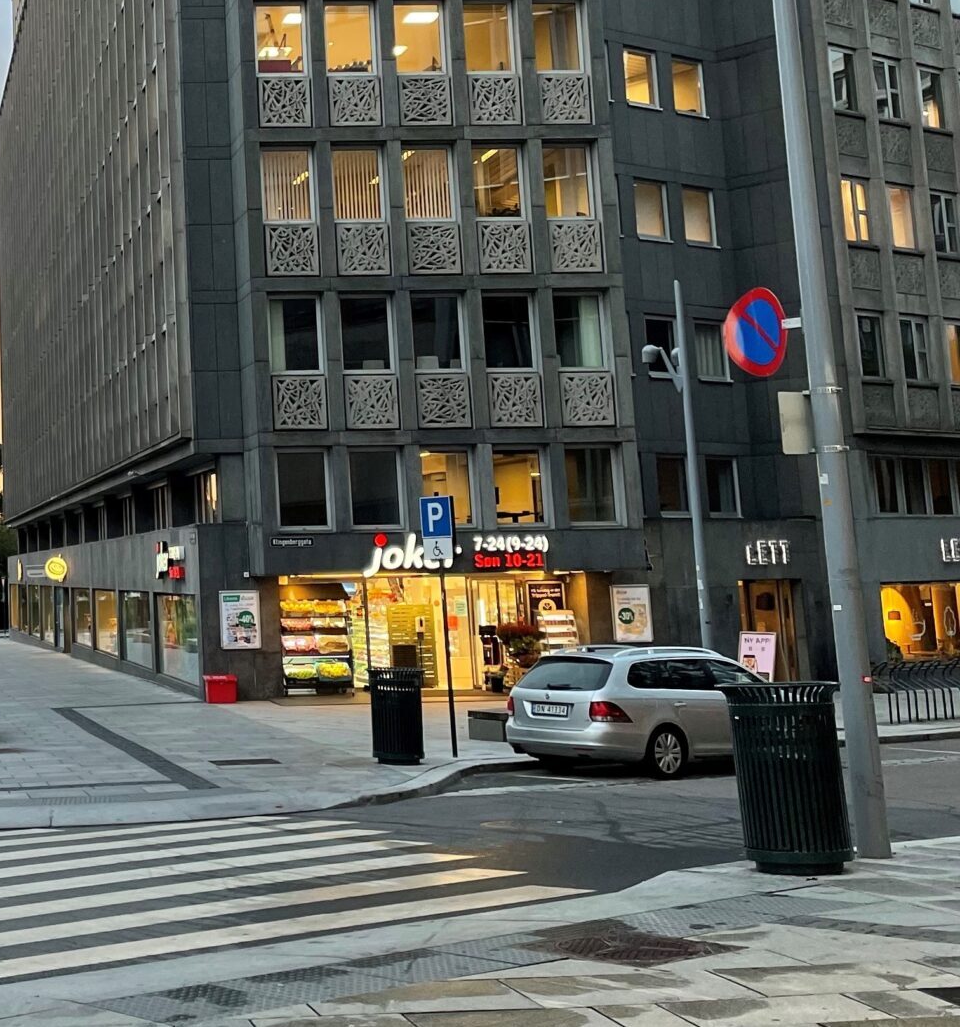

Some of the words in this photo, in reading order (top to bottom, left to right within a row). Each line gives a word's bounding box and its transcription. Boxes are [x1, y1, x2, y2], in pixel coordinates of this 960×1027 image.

[427, 502, 443, 533] P
[363, 533, 462, 578] jok
[504, 553, 544, 568] 10-21
[745, 540, 788, 565] LETT
